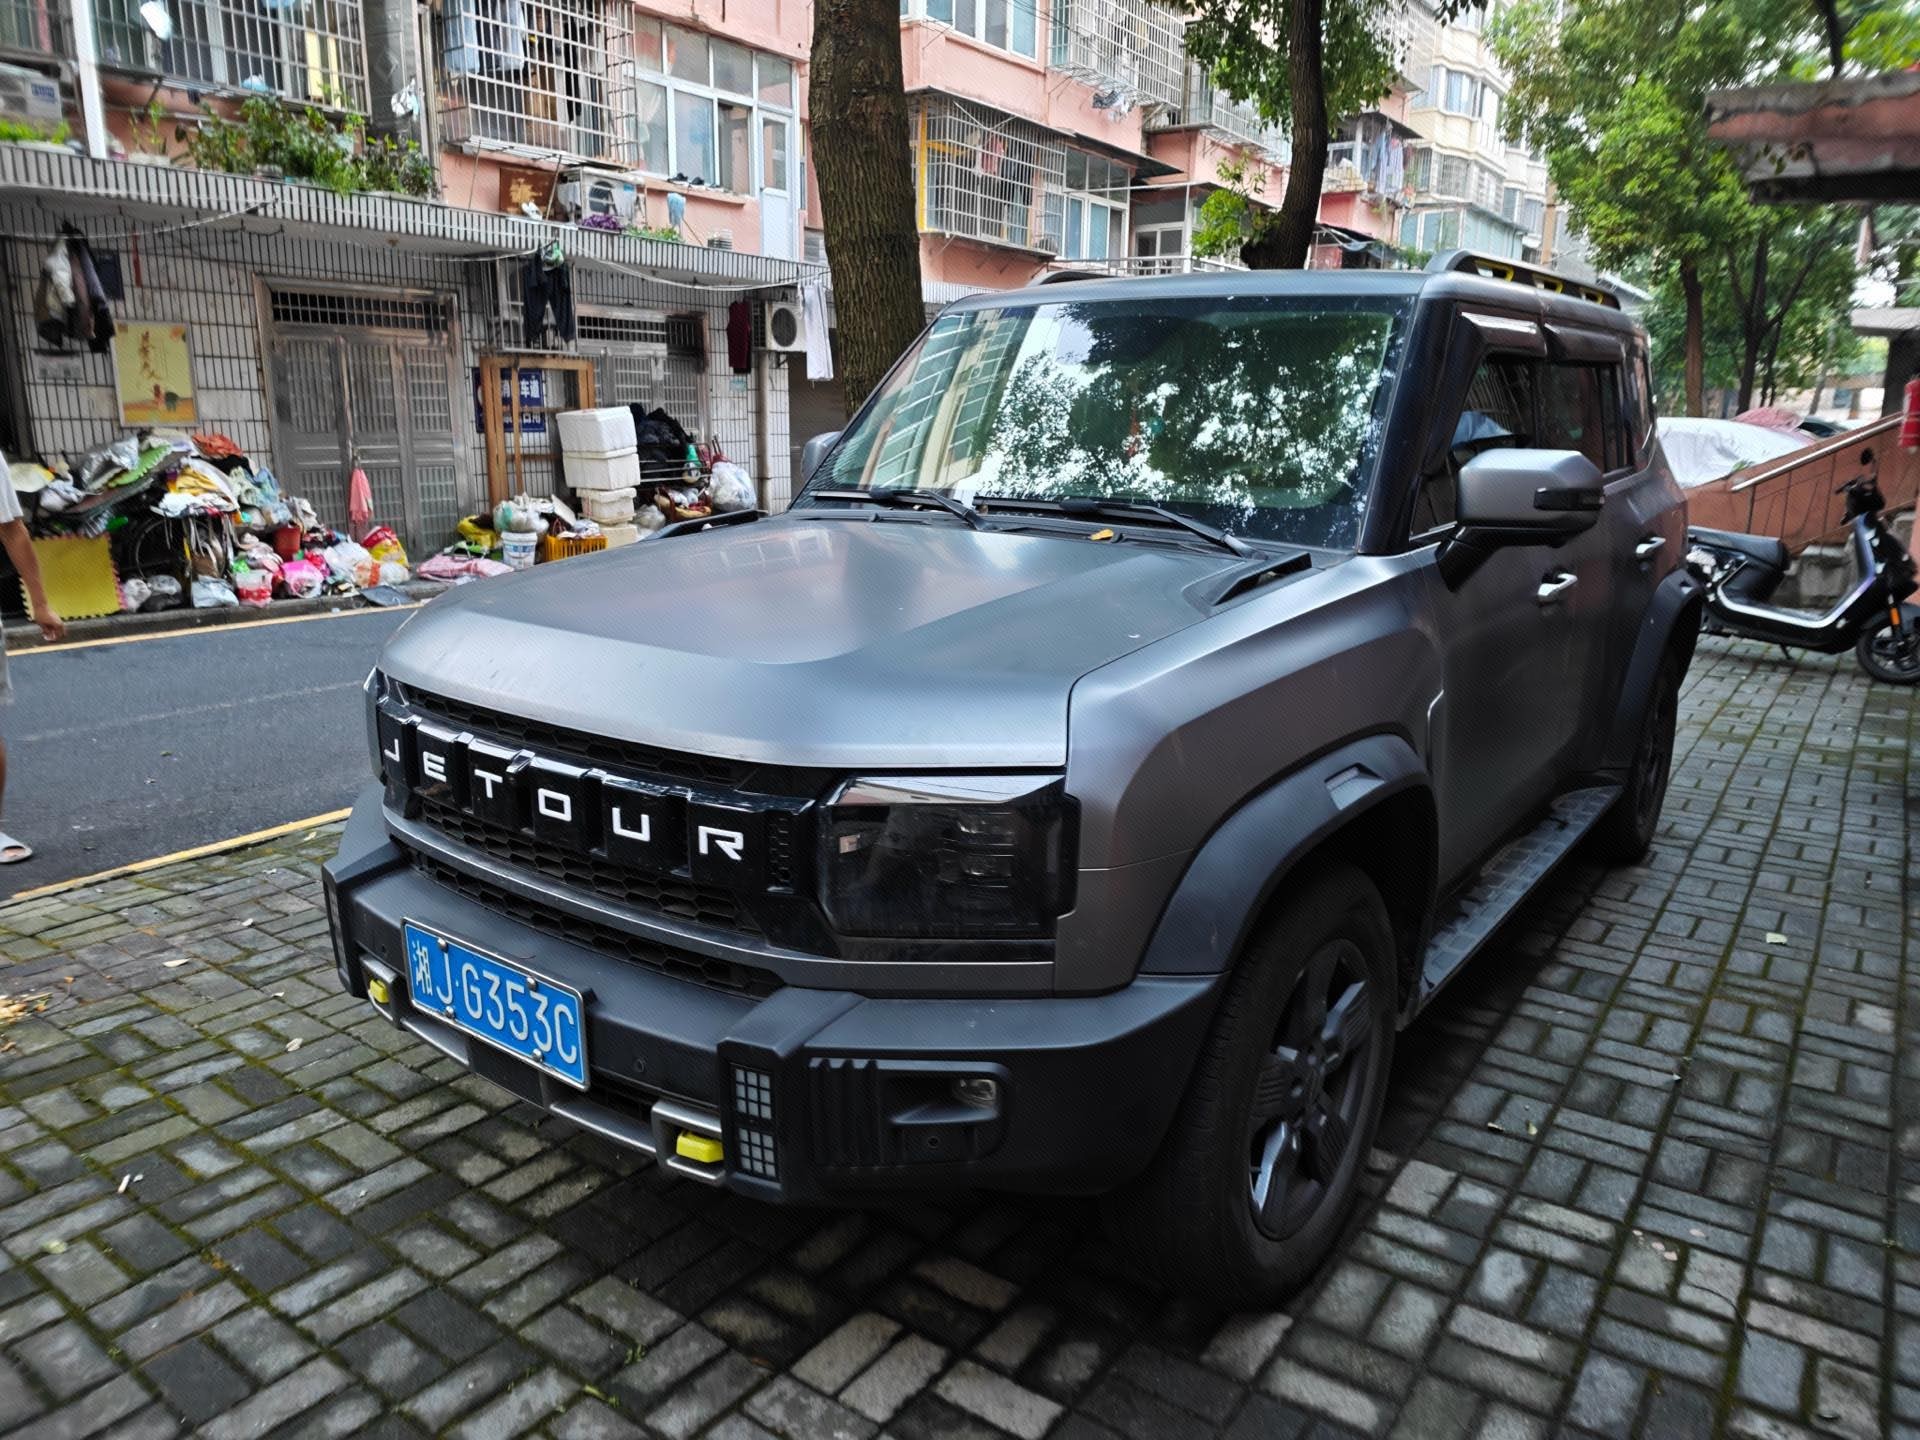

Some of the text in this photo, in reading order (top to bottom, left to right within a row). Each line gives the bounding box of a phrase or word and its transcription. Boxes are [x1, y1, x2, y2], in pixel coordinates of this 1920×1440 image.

[501, 375, 540, 398] 消车道
[384, 738, 744, 861] JETOUR
